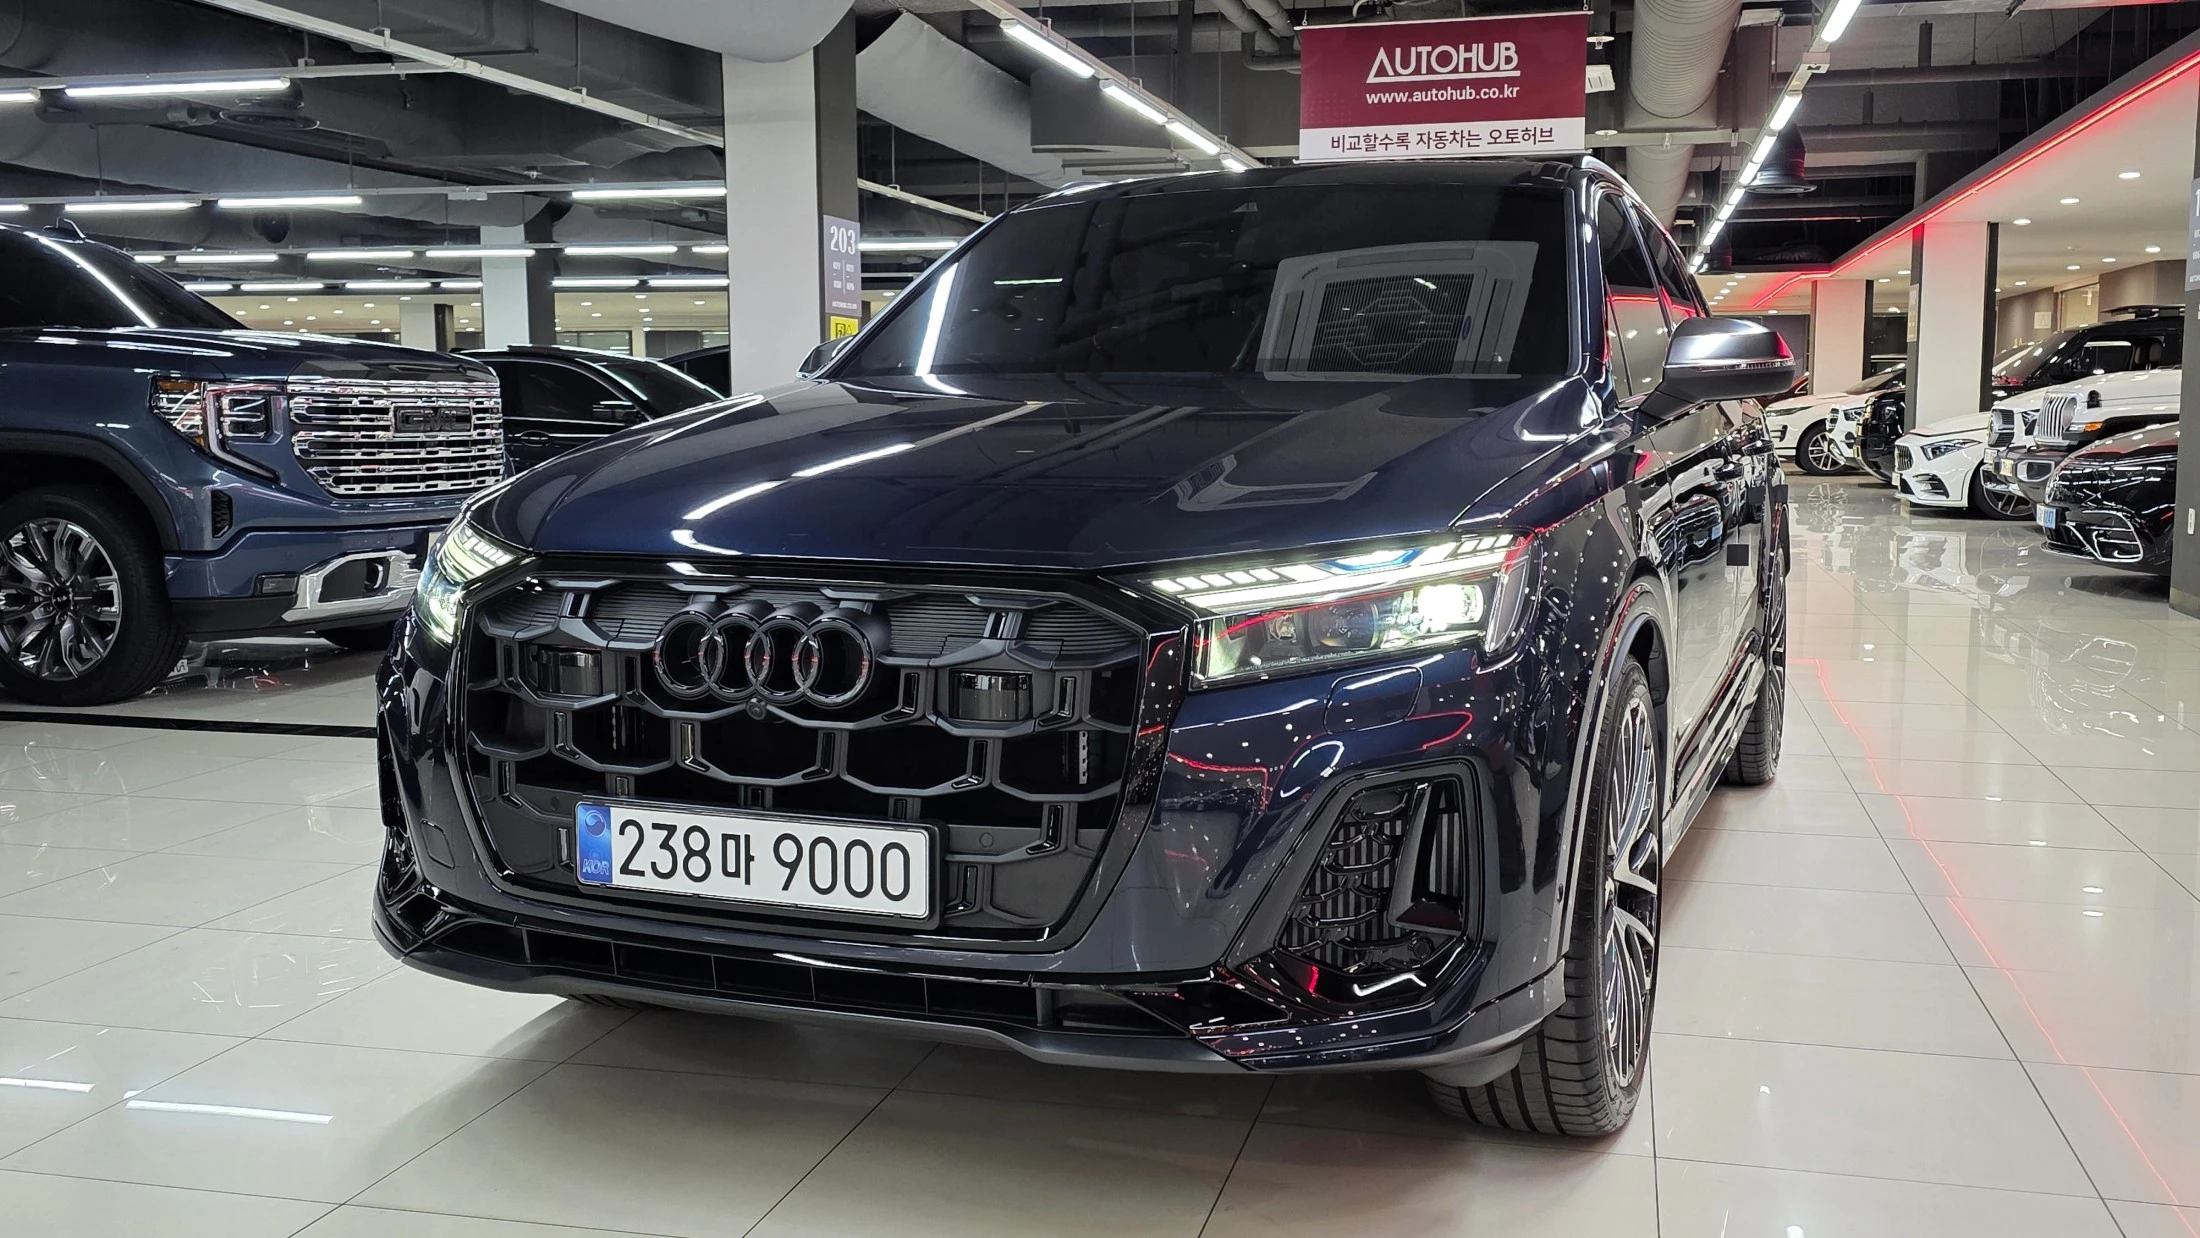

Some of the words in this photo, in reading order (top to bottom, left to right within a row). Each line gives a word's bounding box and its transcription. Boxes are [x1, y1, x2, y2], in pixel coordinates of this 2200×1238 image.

[1366, 41, 1521, 83] AUTOHUB
[1366, 84, 1520, 105] www.autohub.co.kr
[1330, 132, 1412, 153] 비교할수록
[1416, 129, 1483, 150] 자동차는
[1486, 126, 1555, 147] 오토허브
[830, 225, 856, 255] 203
[398, 408, 472, 432] GMC
[582, 858, 610, 876] KOR
[772, 832, 911, 902] 9000
